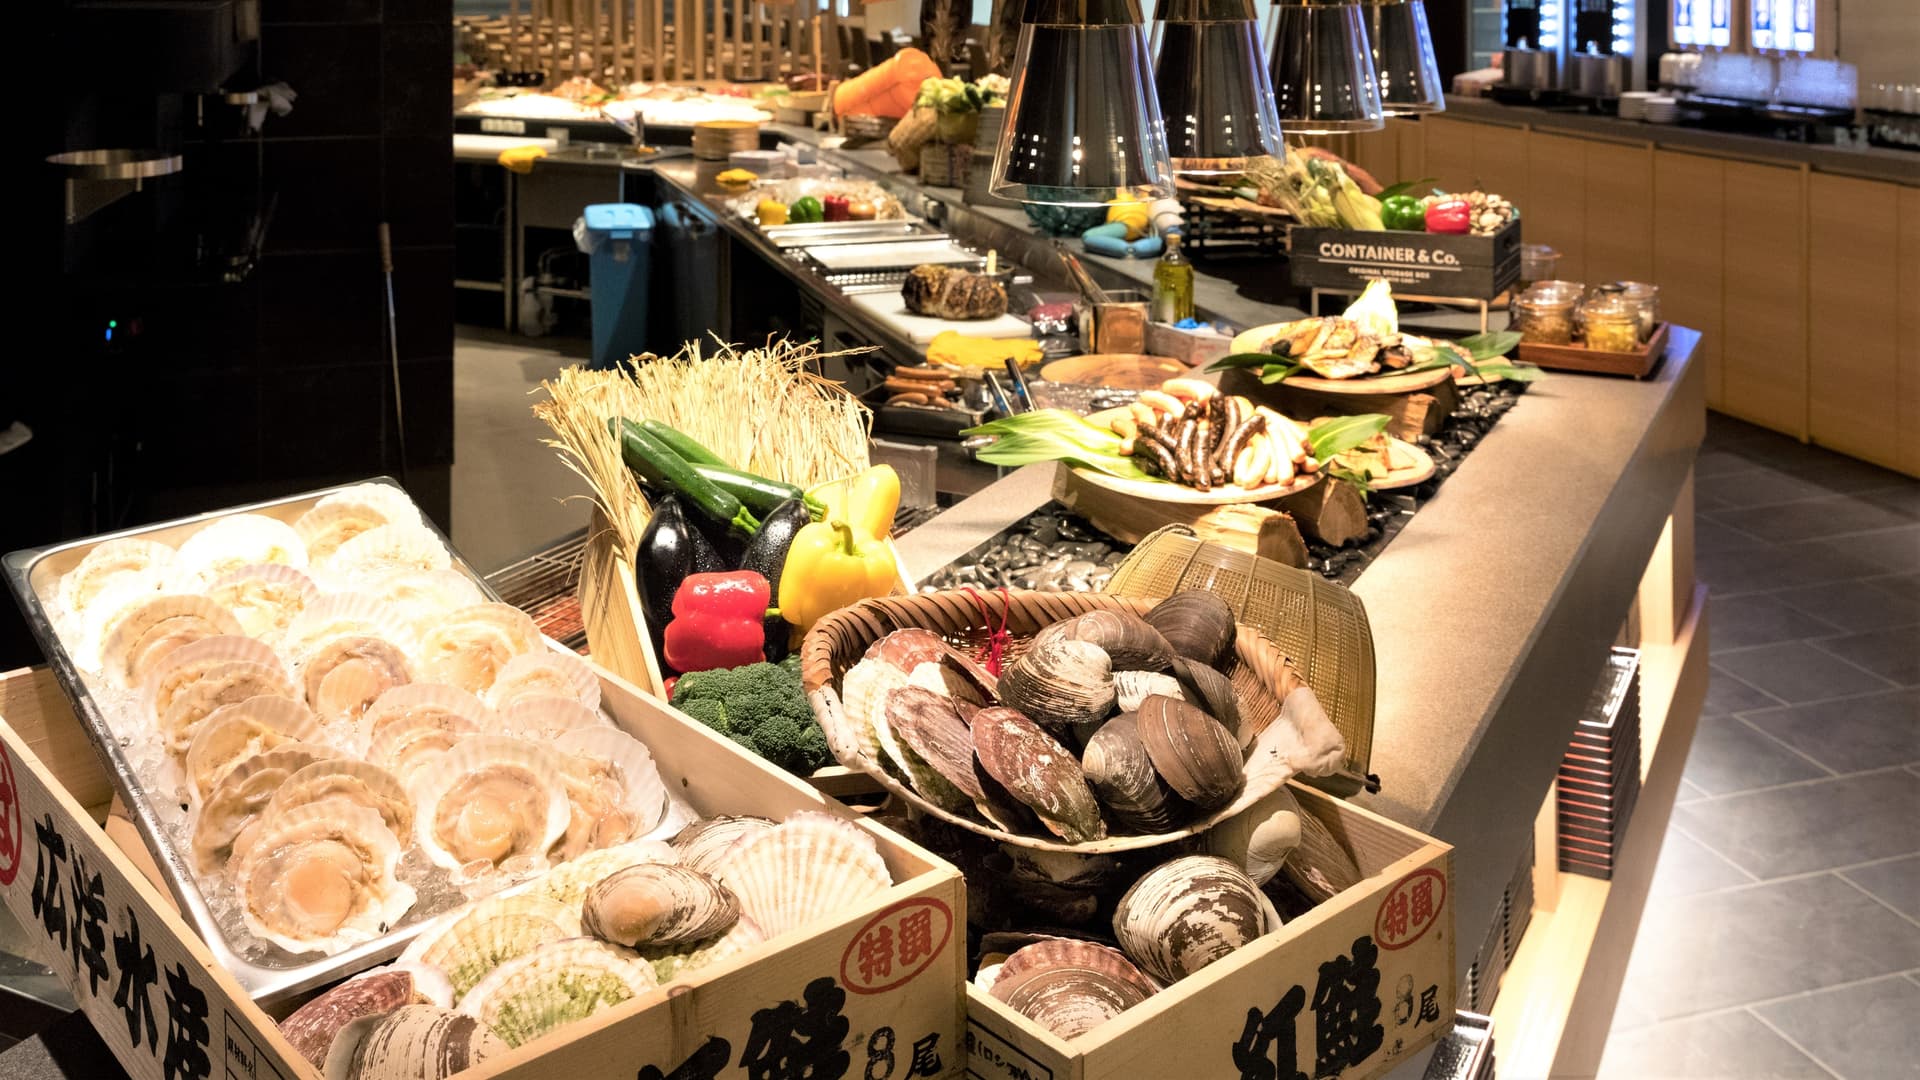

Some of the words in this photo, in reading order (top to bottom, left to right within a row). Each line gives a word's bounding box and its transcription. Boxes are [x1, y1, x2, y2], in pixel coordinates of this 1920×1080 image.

[1319, 243, 1415, 263] CONTAINER
[1417, 250, 1430, 264] &
[1432, 251, 1460, 265] Co.
